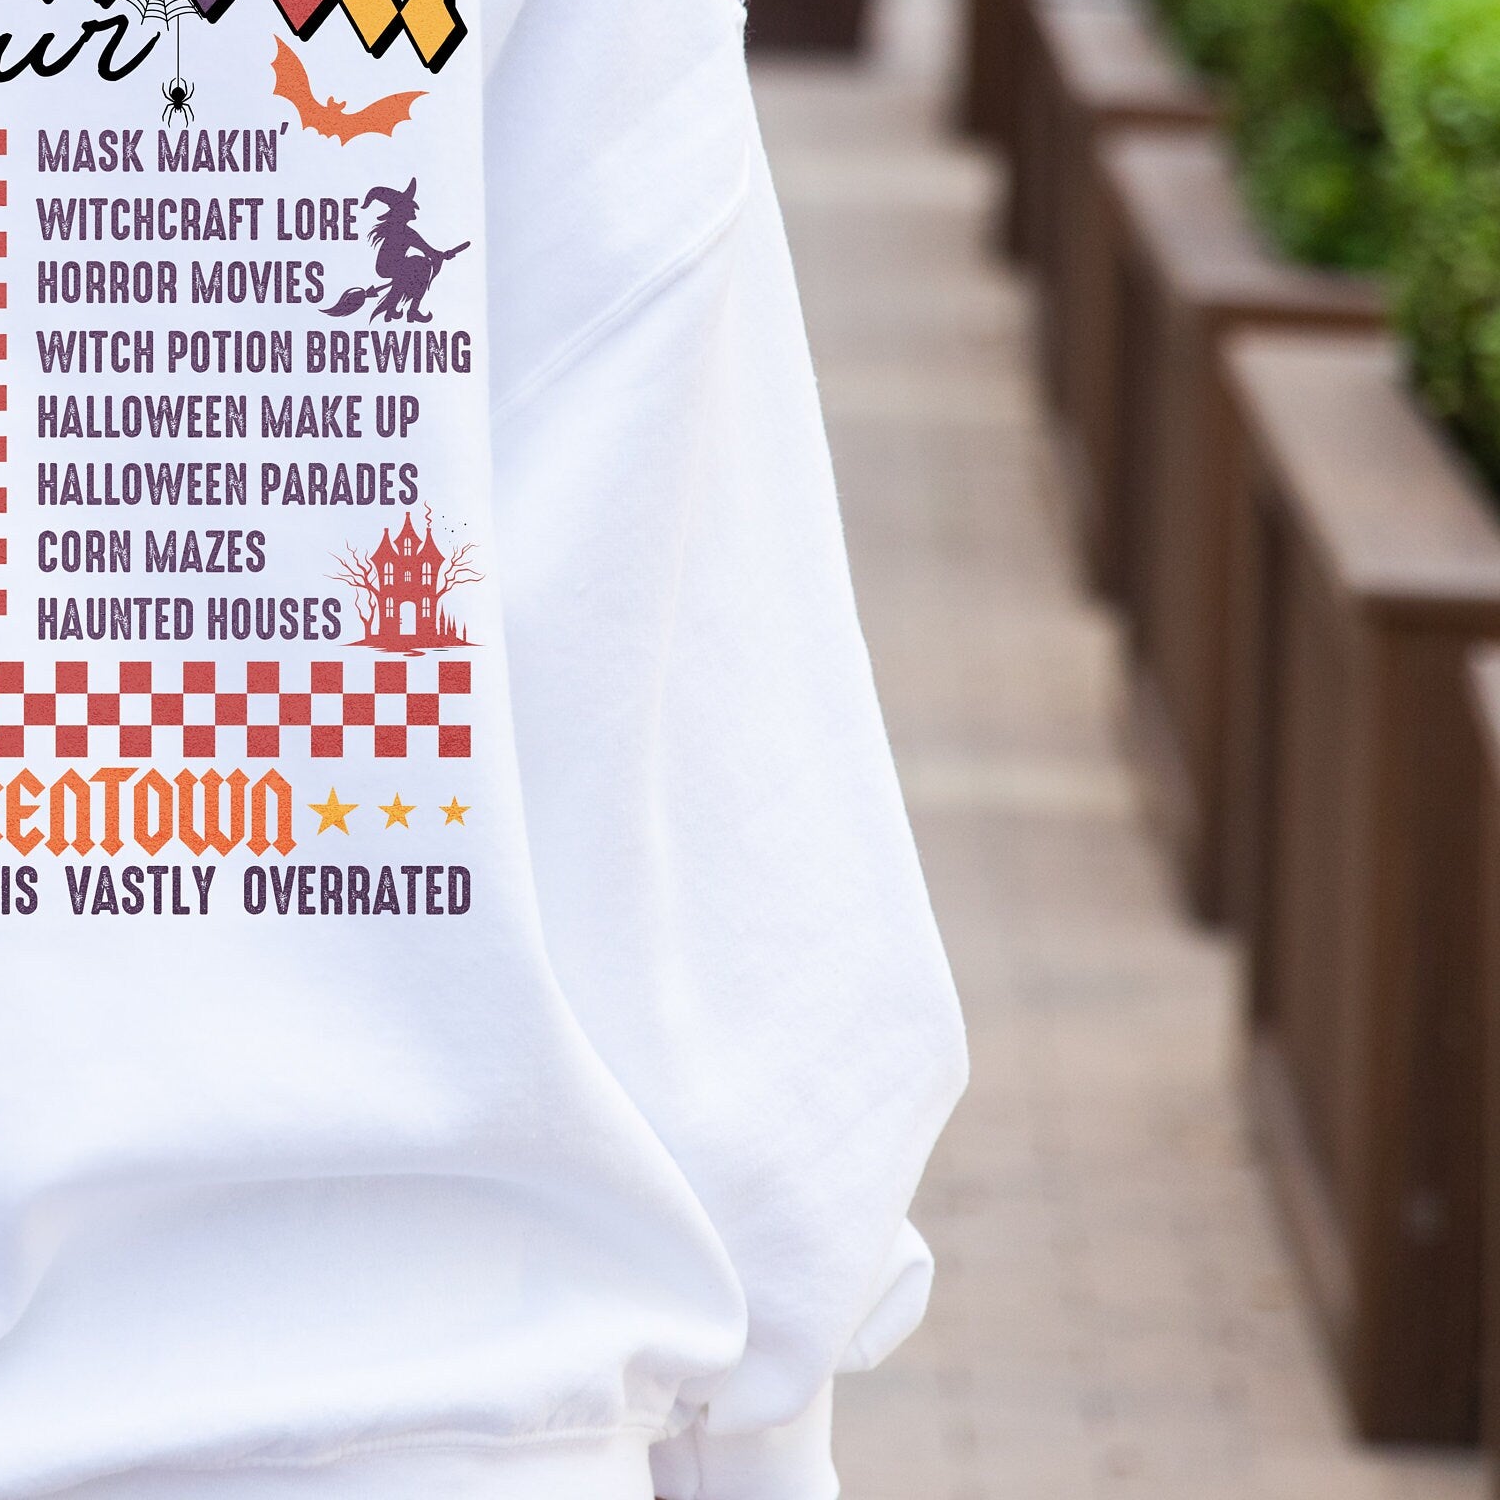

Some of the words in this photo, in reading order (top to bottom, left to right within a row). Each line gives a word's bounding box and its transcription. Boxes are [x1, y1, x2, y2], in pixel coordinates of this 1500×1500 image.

[38, 129, 144, 172] MASK
[157, 122, 289, 172] MAKIN'
[36, 198, 263, 241] WITCHCRAFT
[278, 198, 359, 241] LORE
[38, 261, 177, 303] HORROR
[192, 261, 324, 303] MOVIES
[36, 331, 154, 373] WITCH
[168, 331, 292, 373] POTION
[307, 331, 471, 373] BREWING
[38, 395, 247, 438] HALLOWEEN
[261, 395, 362, 438] MAKE
[376, 395, 419, 438] UP
[38, 463, 247, 505] HALLOWEEN
[261, 463, 418, 505] PARADES
[38, 530, 130, 573] CORN
[145, 530, 266, 573] MAZES
[38, 597, 194, 640] HAUNTED
[207, 597, 341, 640] HOUSES
[1, 865, 38, 915] IS
[65, 865, 216, 915] VASTLY
[244, 865, 471, 915] OVERRATED
